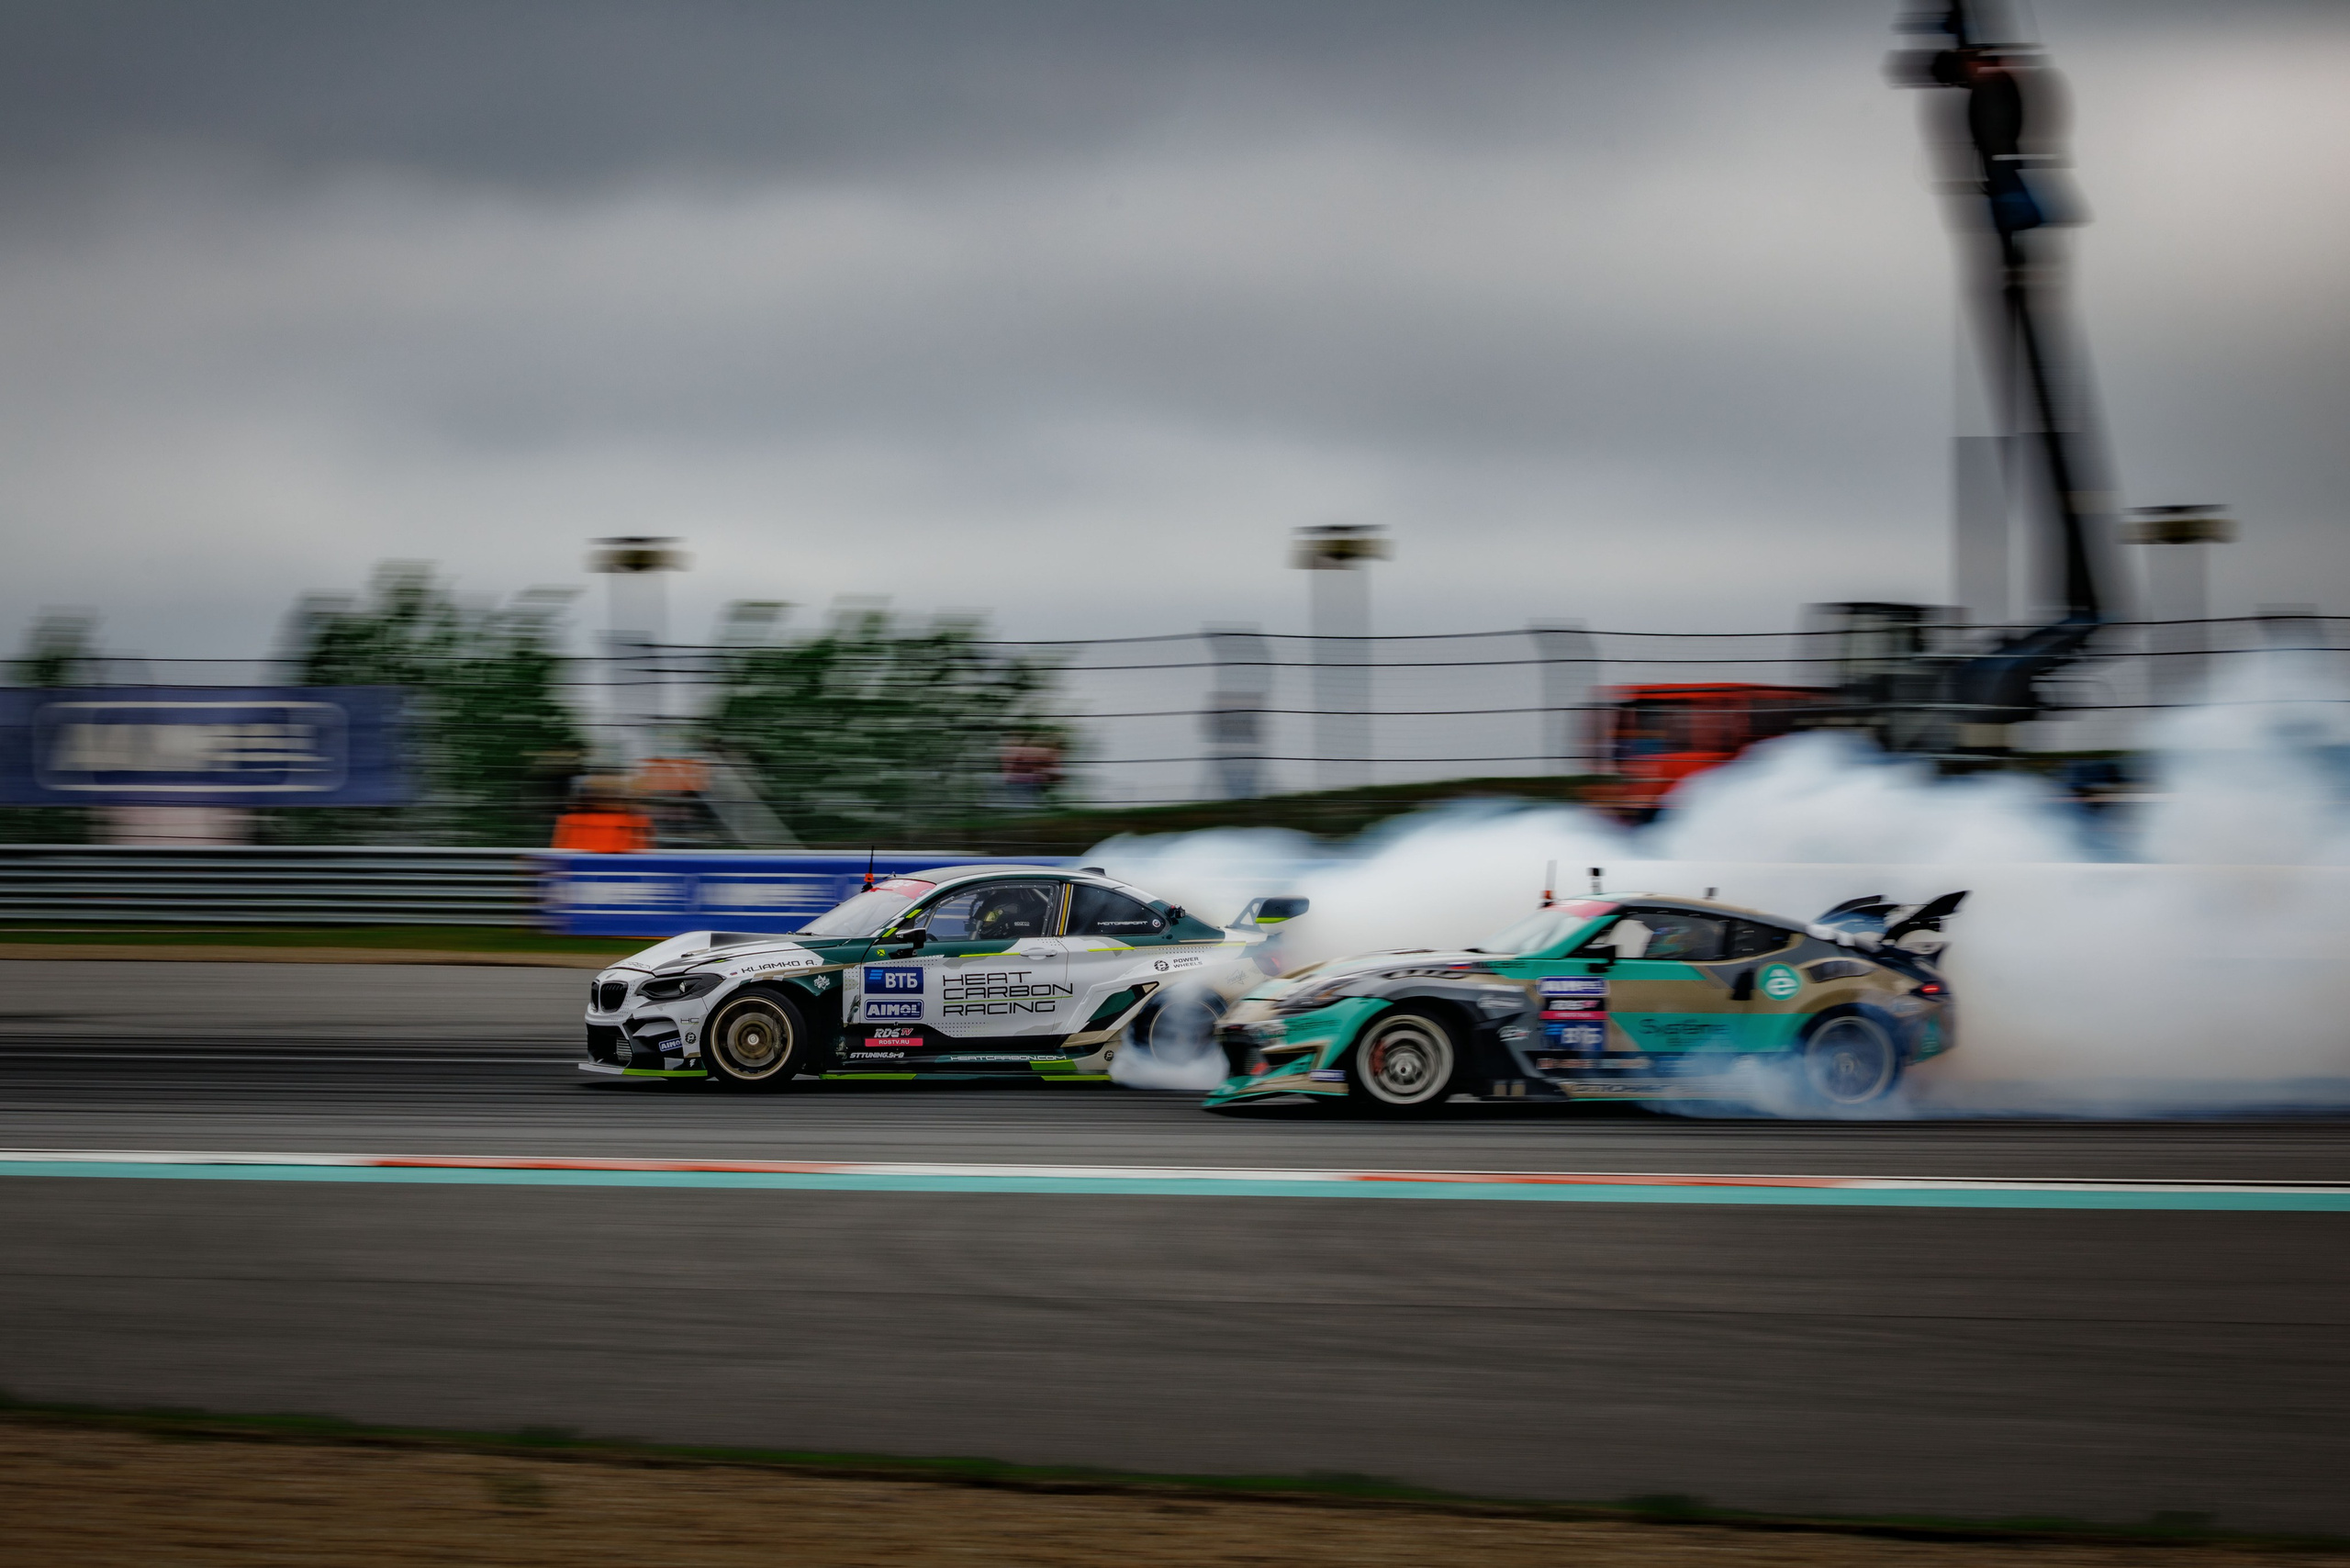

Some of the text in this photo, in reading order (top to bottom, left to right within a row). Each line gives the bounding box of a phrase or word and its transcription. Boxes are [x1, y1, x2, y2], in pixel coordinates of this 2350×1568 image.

[741, 960, 800, 974] KLIAMKO
[885, 973, 918, 989] ВТБ
[943, 971, 1032, 987] HEAT
[943, 983, 1074, 1000] CARBON
[867, 1004, 921, 1016] AIMOL
[943, 1001, 1056, 1016] RACING
